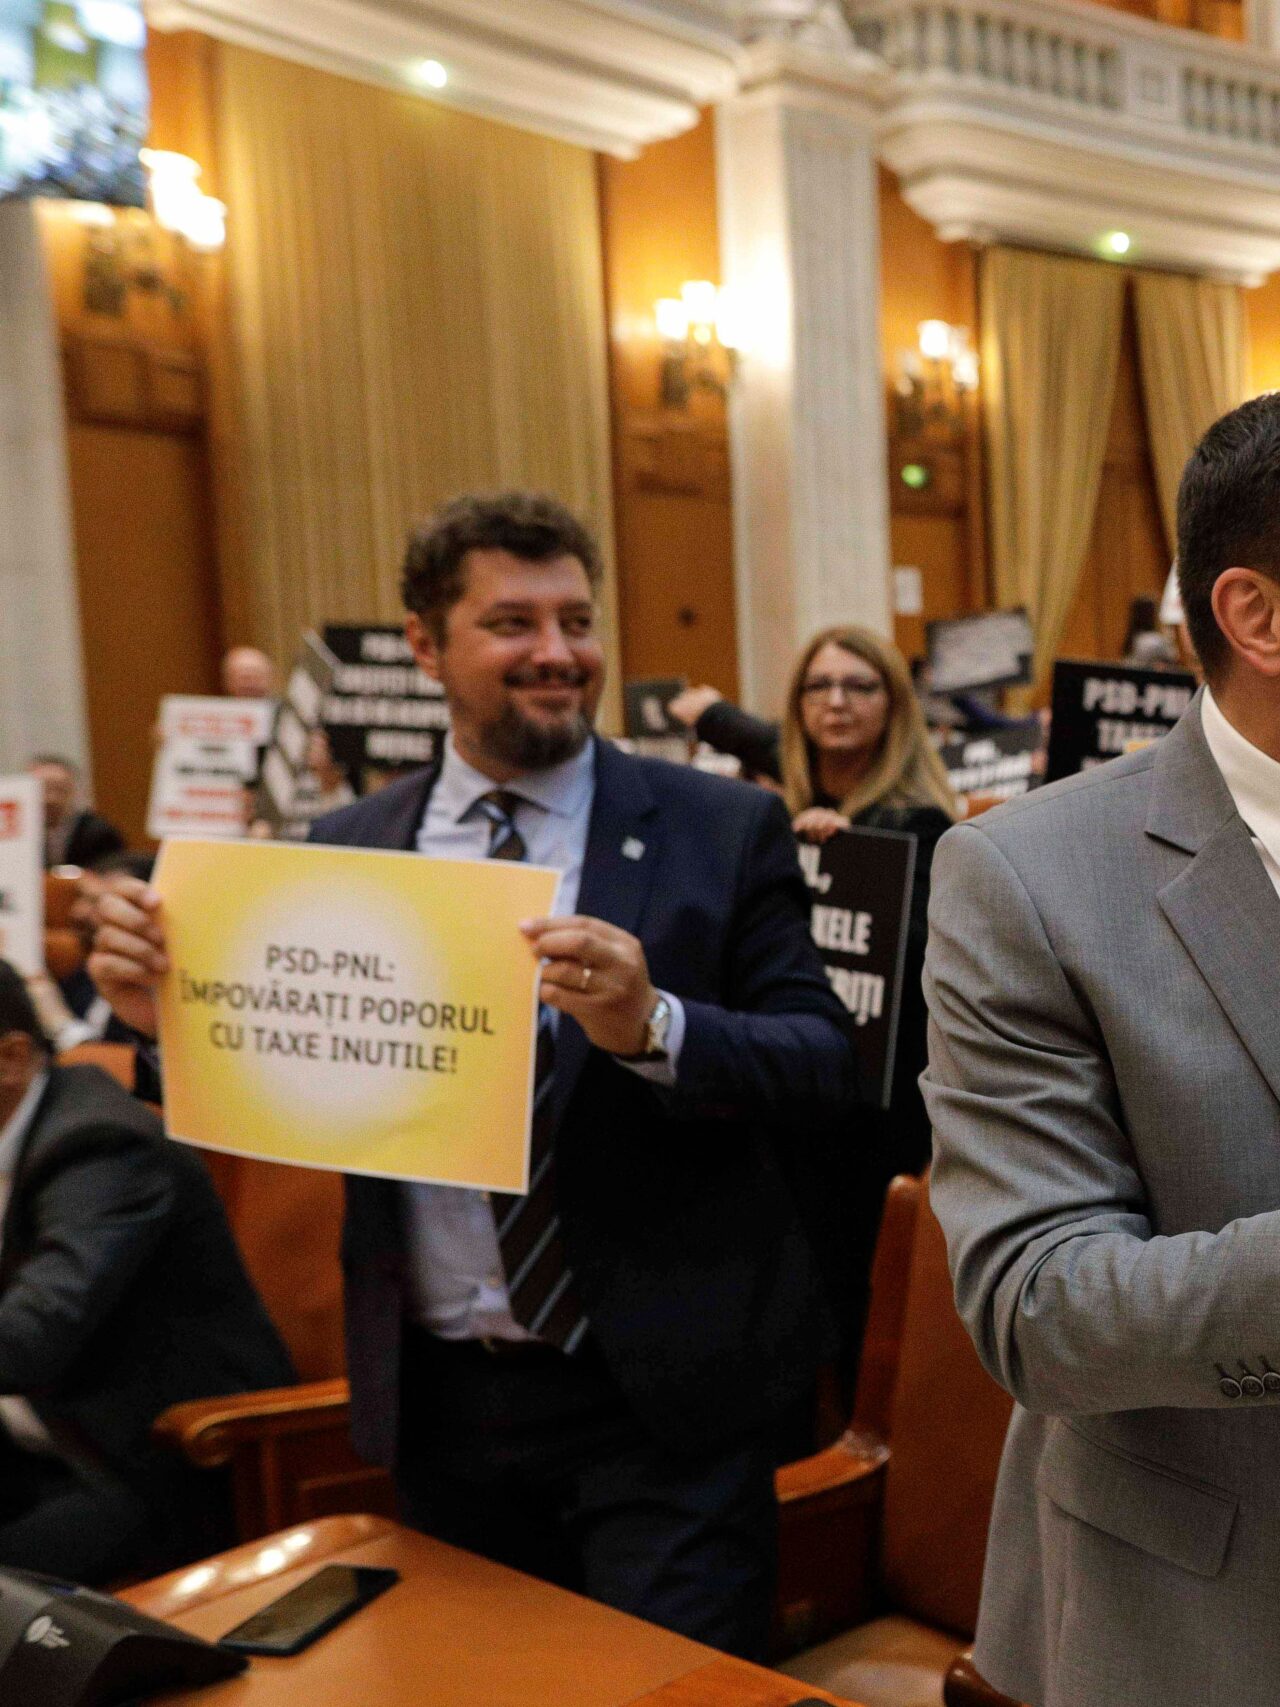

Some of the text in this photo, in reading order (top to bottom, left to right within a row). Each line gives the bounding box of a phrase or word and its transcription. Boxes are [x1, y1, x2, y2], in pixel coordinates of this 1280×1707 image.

[265, 944, 395, 983] PSD-PNL:
[179, 967, 495, 1036] ÎMPOVĂRAȚI POPORUL
[209, 1020, 459, 1074] CU TAXE INUTILE!
